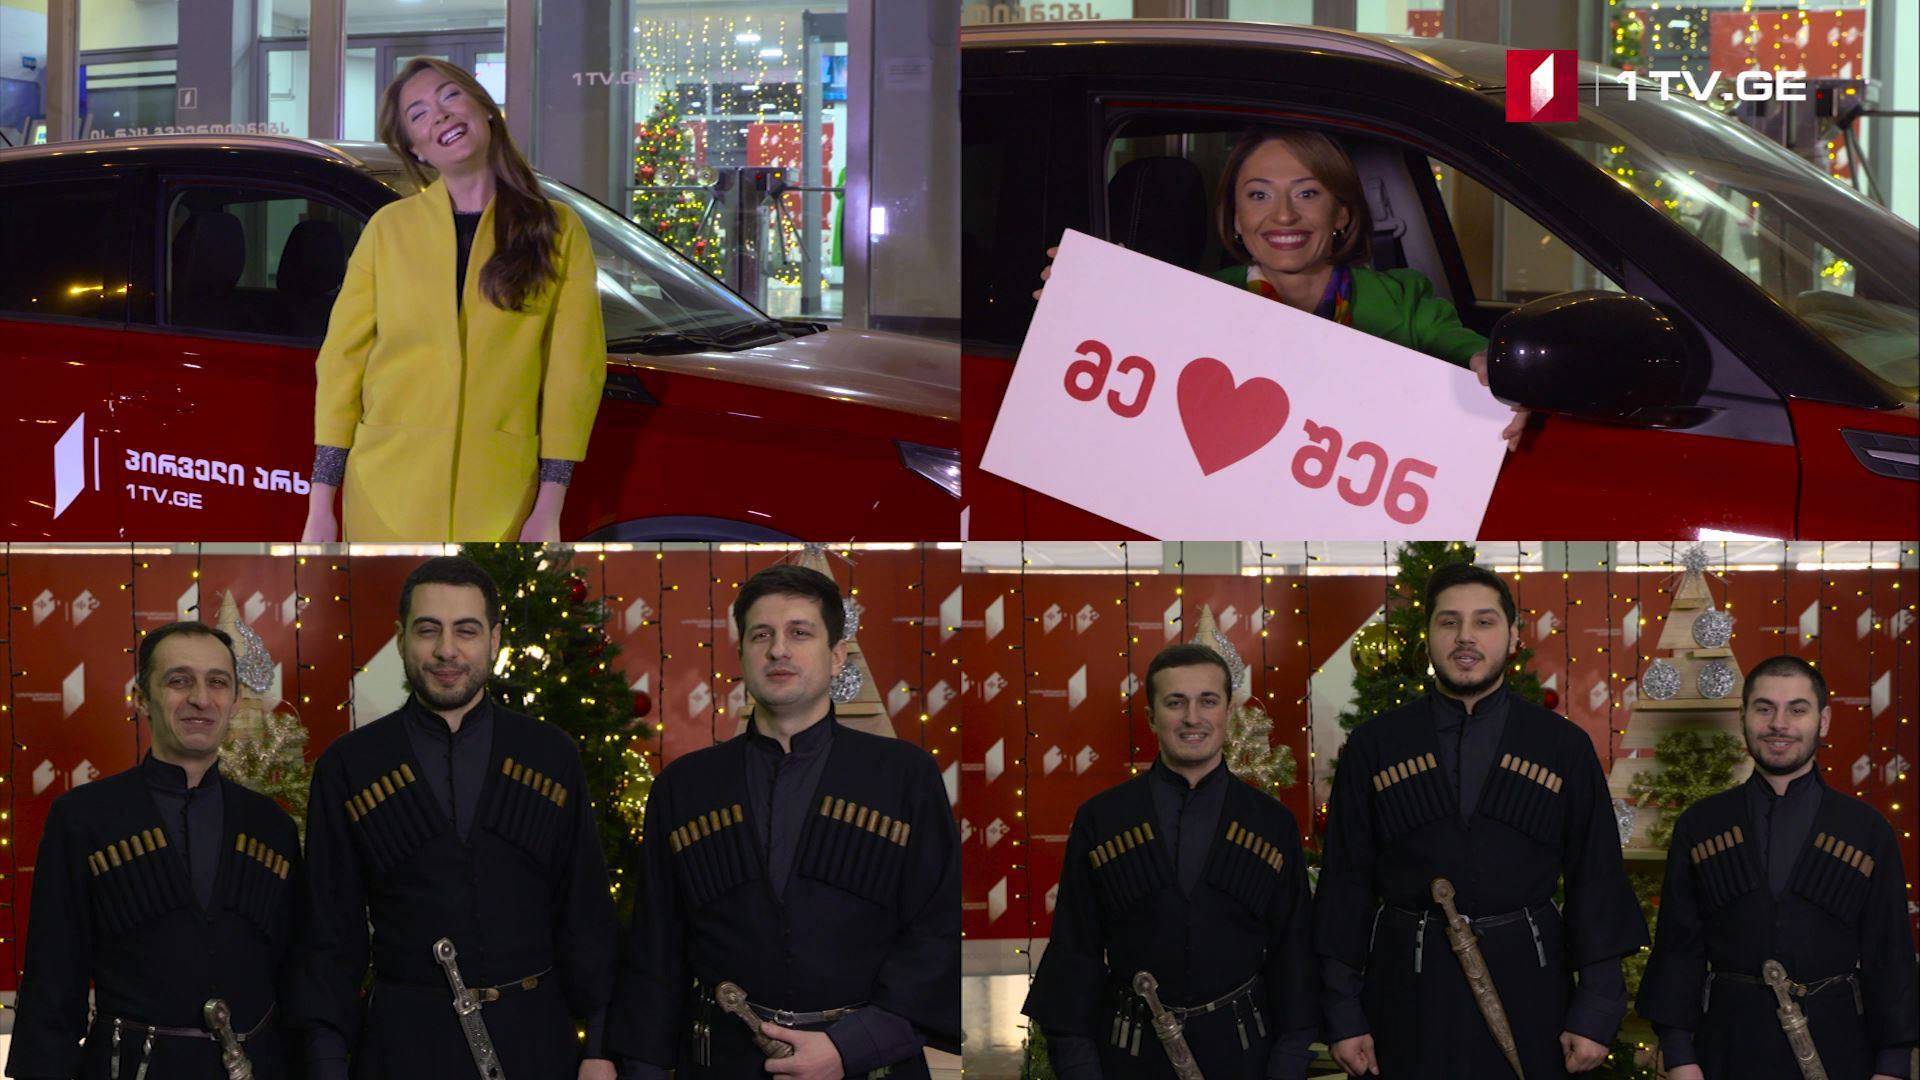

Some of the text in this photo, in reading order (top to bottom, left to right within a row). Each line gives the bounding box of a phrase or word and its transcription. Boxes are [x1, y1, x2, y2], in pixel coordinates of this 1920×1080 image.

[1063, 339, 1438, 525] მე შენ
[124, 448, 245, 487] პირველი
[126, 483, 203, 509] 1TV.GE
